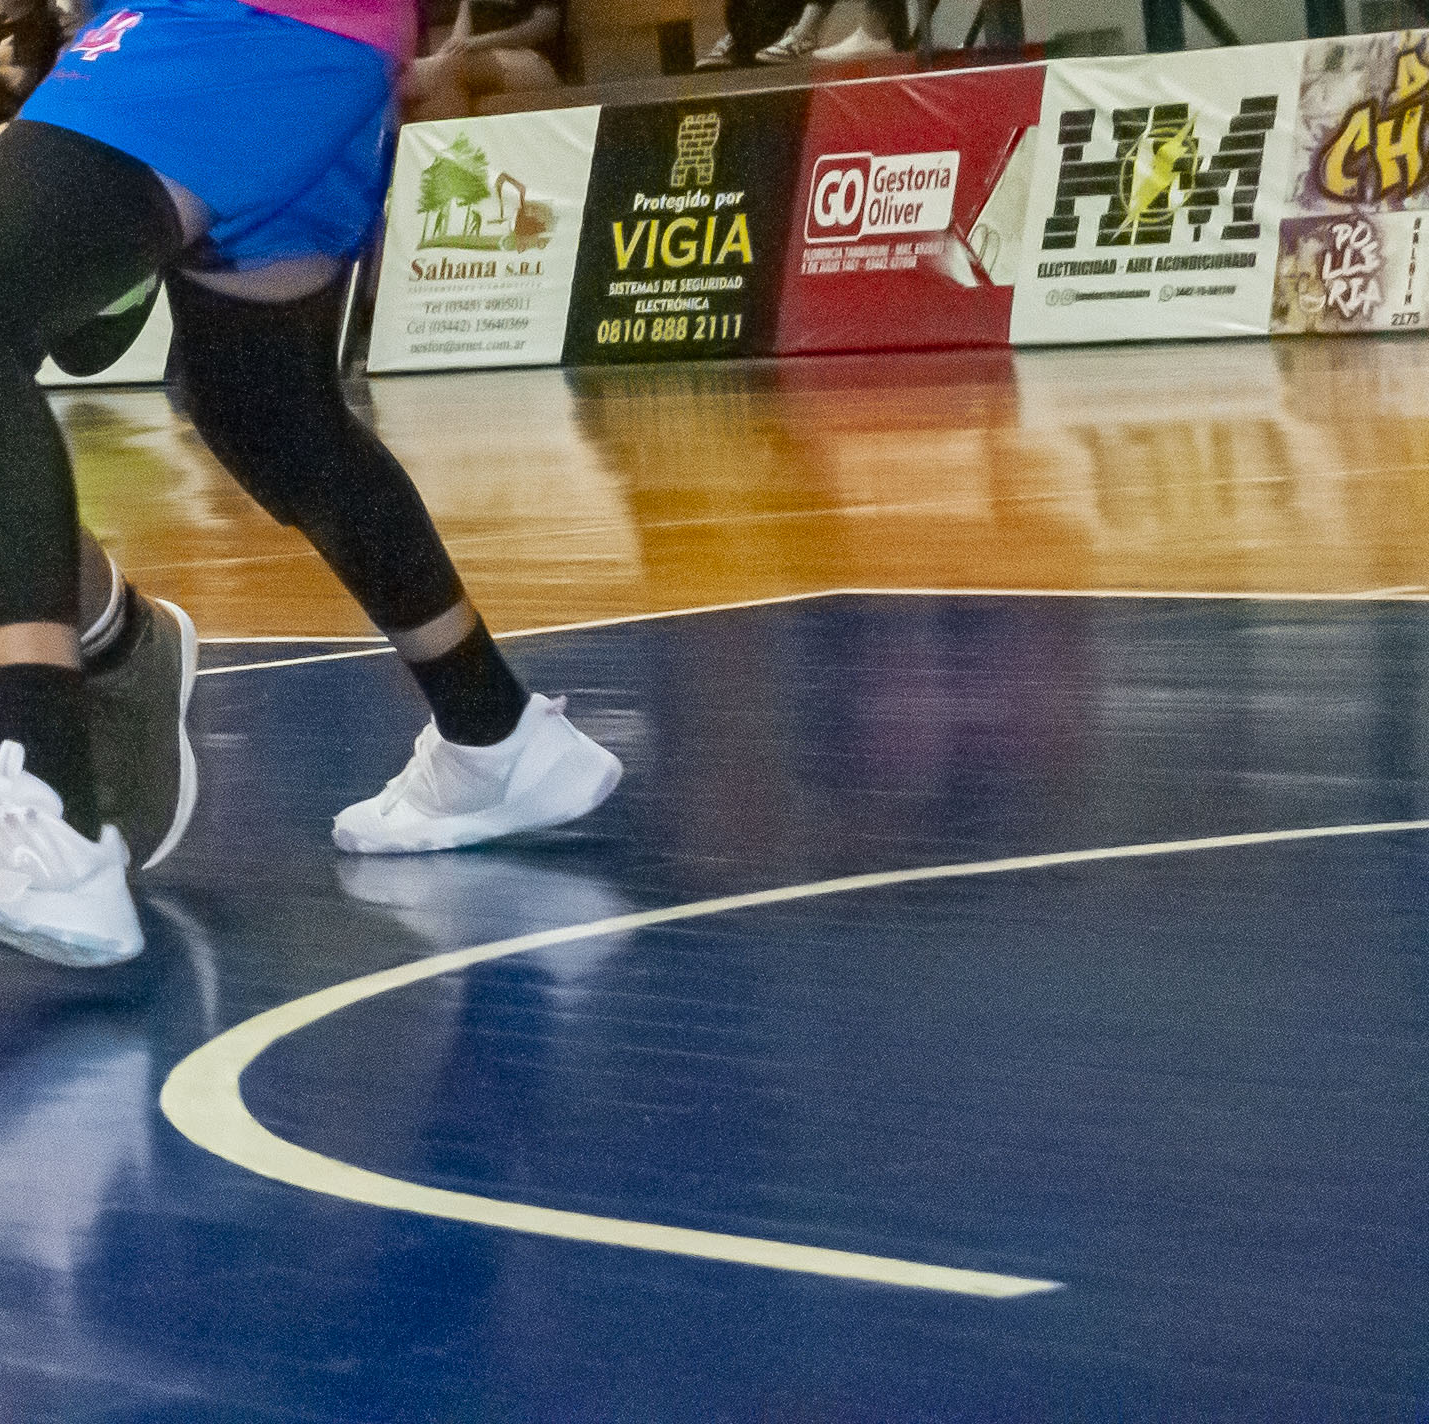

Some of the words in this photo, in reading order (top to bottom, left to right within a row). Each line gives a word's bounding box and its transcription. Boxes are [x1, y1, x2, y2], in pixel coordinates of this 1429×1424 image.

[633, 189, 711, 213] Protegido
[714, 190, 745, 211] por
[813, 168, 865, 227] GO
[868, 194, 924, 226] Oliver
[612, 212, 753, 271] VIGIA
[408, 257, 497, 283] Sahana
[1037, 259, 1117, 279] ELECTRICIDAD
[1155, 252, 1257, 272] ACONDICIONADO
[608, 280, 660, 297] SISTEMAS
[662, 279, 677, 294] DE
[679, 276, 743, 293] SEGURIDAD
[597, 319, 646, 344] 0810
[651, 316, 689, 342] 888
[693, 314, 742, 340] 2111
